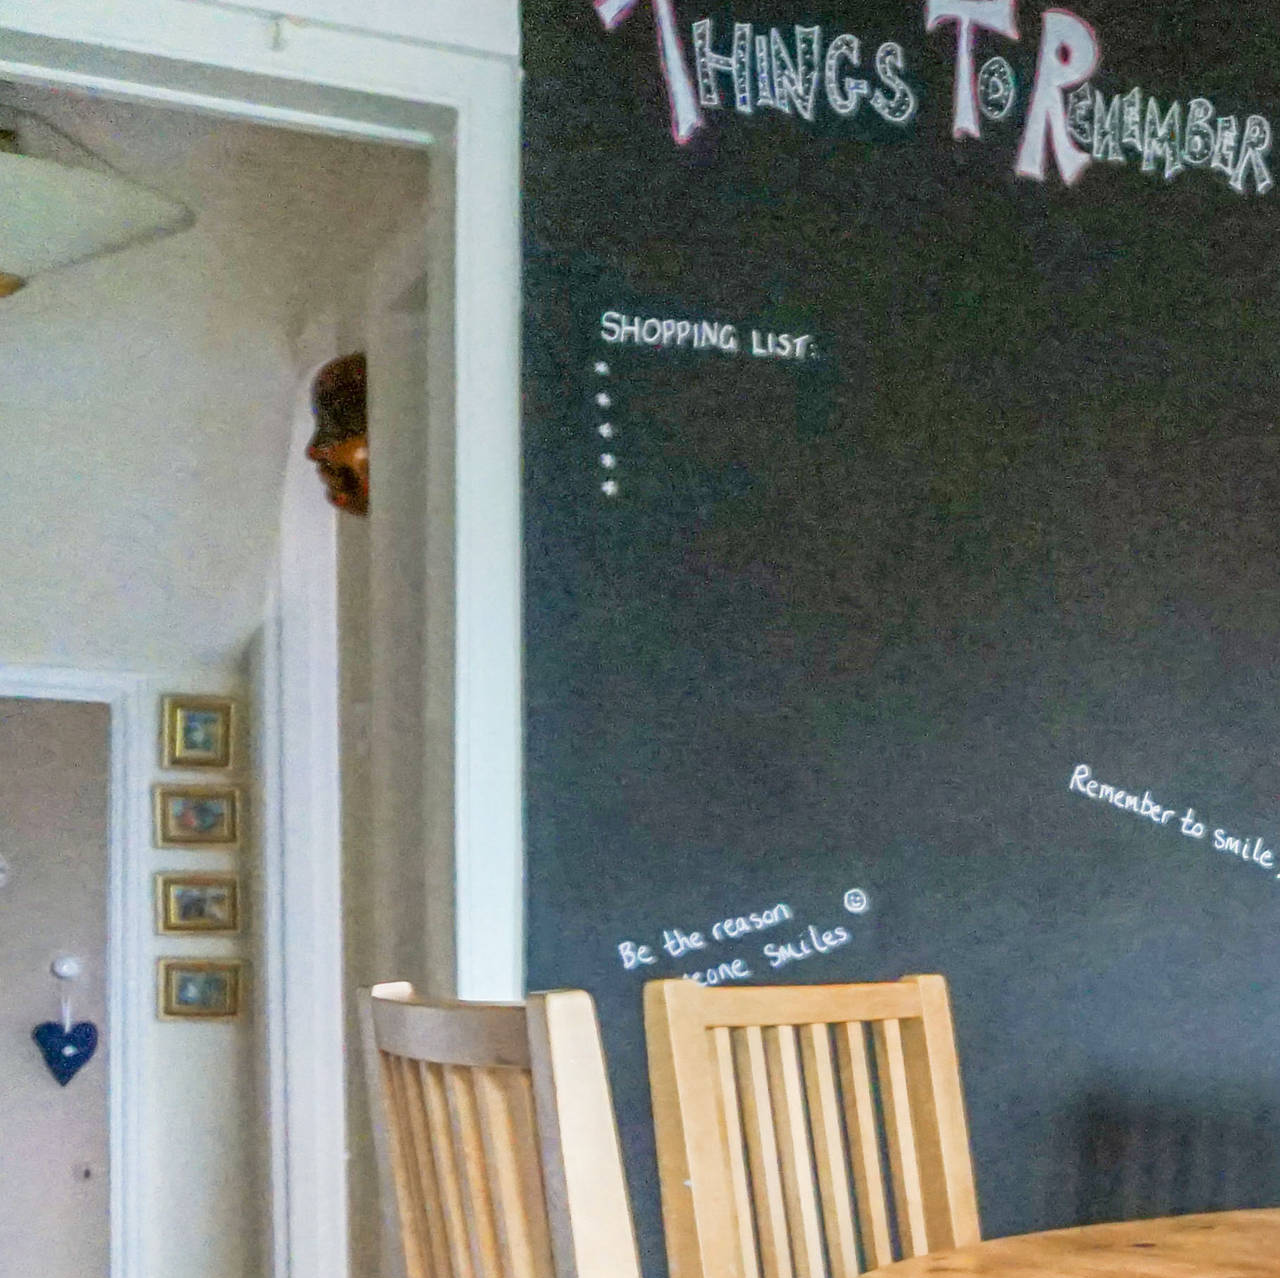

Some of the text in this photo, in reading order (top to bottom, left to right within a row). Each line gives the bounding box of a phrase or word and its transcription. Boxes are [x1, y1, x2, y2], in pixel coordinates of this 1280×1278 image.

[600, 310, 738, 351] SHOPPING
[1069, 764, 1175, 824] Remember
[1180, 807, 1204, 838] to
[618, 903, 795, 969] Be the reason
